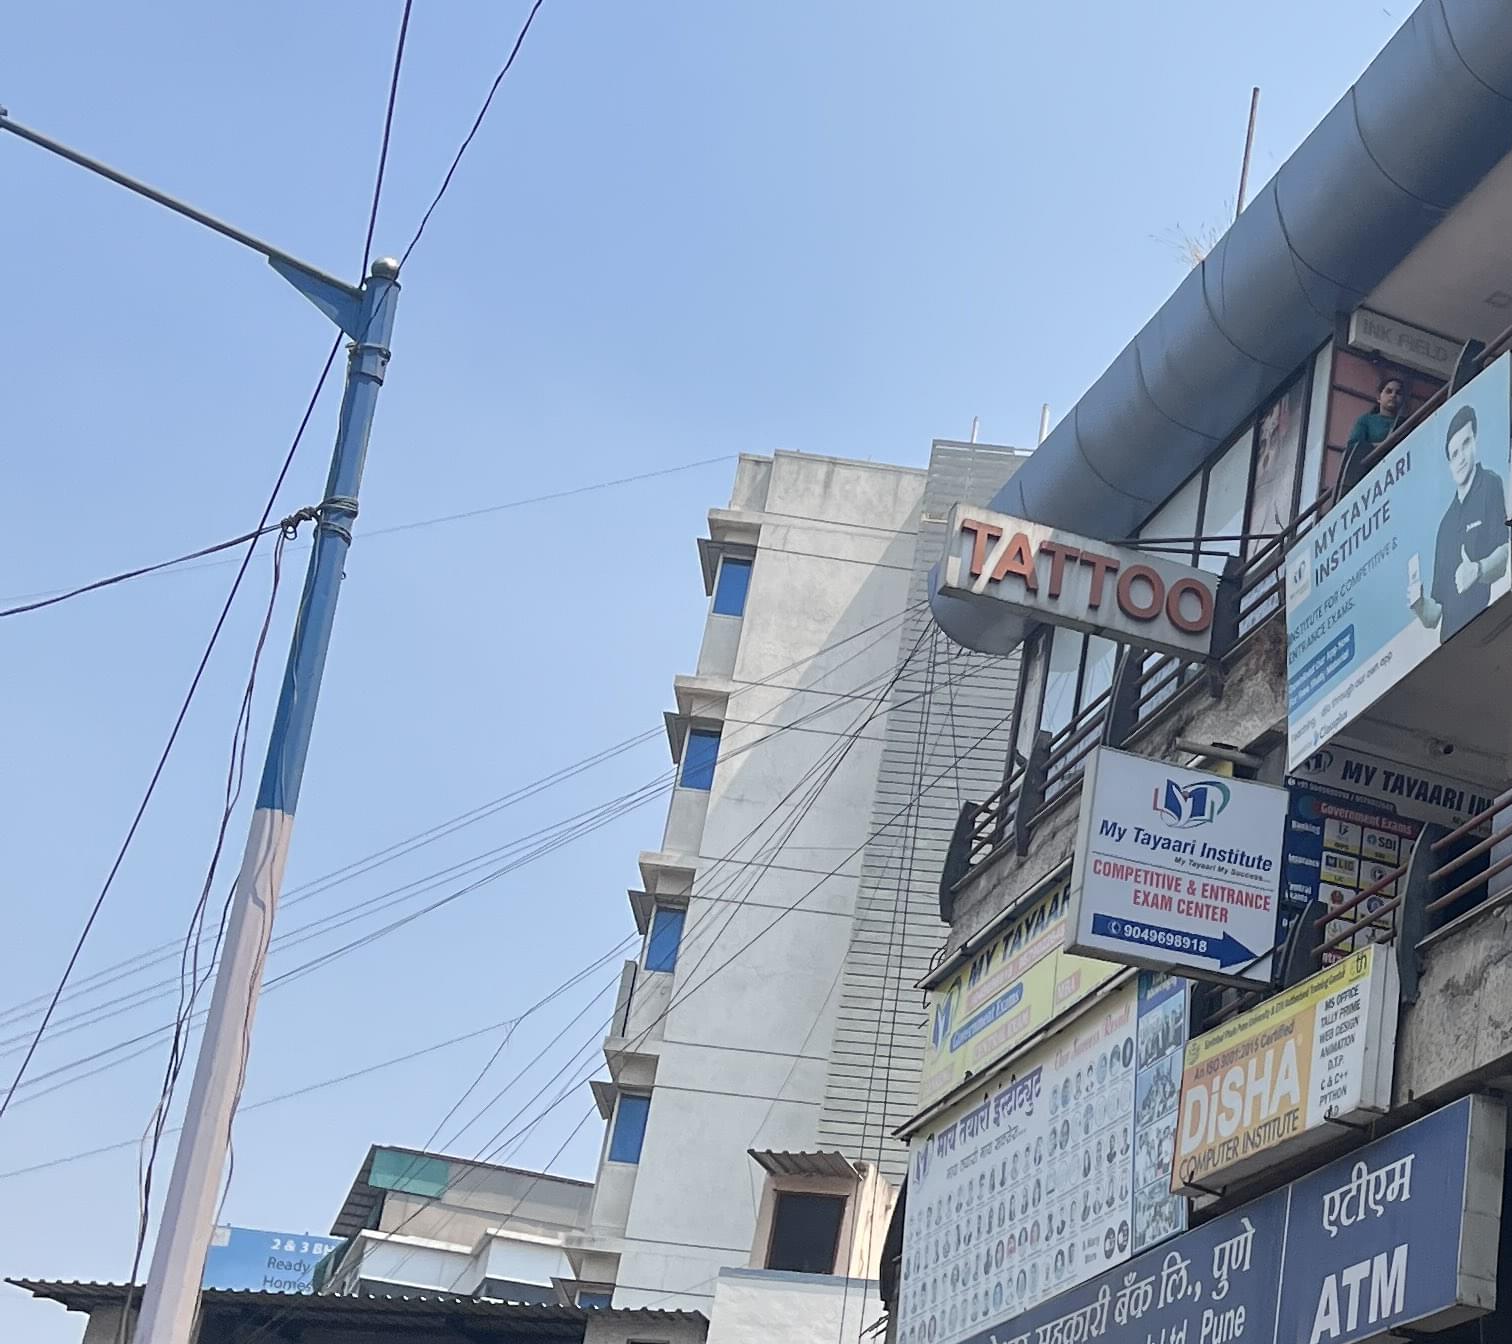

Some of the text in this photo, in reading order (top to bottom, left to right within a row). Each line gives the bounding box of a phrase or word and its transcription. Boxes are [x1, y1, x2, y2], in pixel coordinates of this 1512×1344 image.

[1313, 451, 1412, 559] MY TAYAARI
[1315, 500, 1391, 587] INSTITUTE
[960, 518, 1214, 633] TATTOO
[1341, 760, 1378, 787] MY
[1381, 770, 1464, 811] TAYAARI
[1099, 819, 1273, 873] My Tayaari Institute
[1092, 859, 1272, 913] COMPETITIVE & ENTRANCE
[1132, 889, 1229, 924] EXAM CENTER
[1123, 924, 1208, 954] 9049698918
[1181, 1039, 1301, 1155] DiSHA
[1319, 1083, 1348, 1106] PYTHON
[1178, 1108, 1300, 1183] COMPUTER INSTITUTE
[1322, 1153, 1416, 1238] एटीएम
[266, 1256, 312, 1276] Ready
[270, 1238, 310, 1254] 2 3
[1211, 1216, 1256, 1302] पुणे
